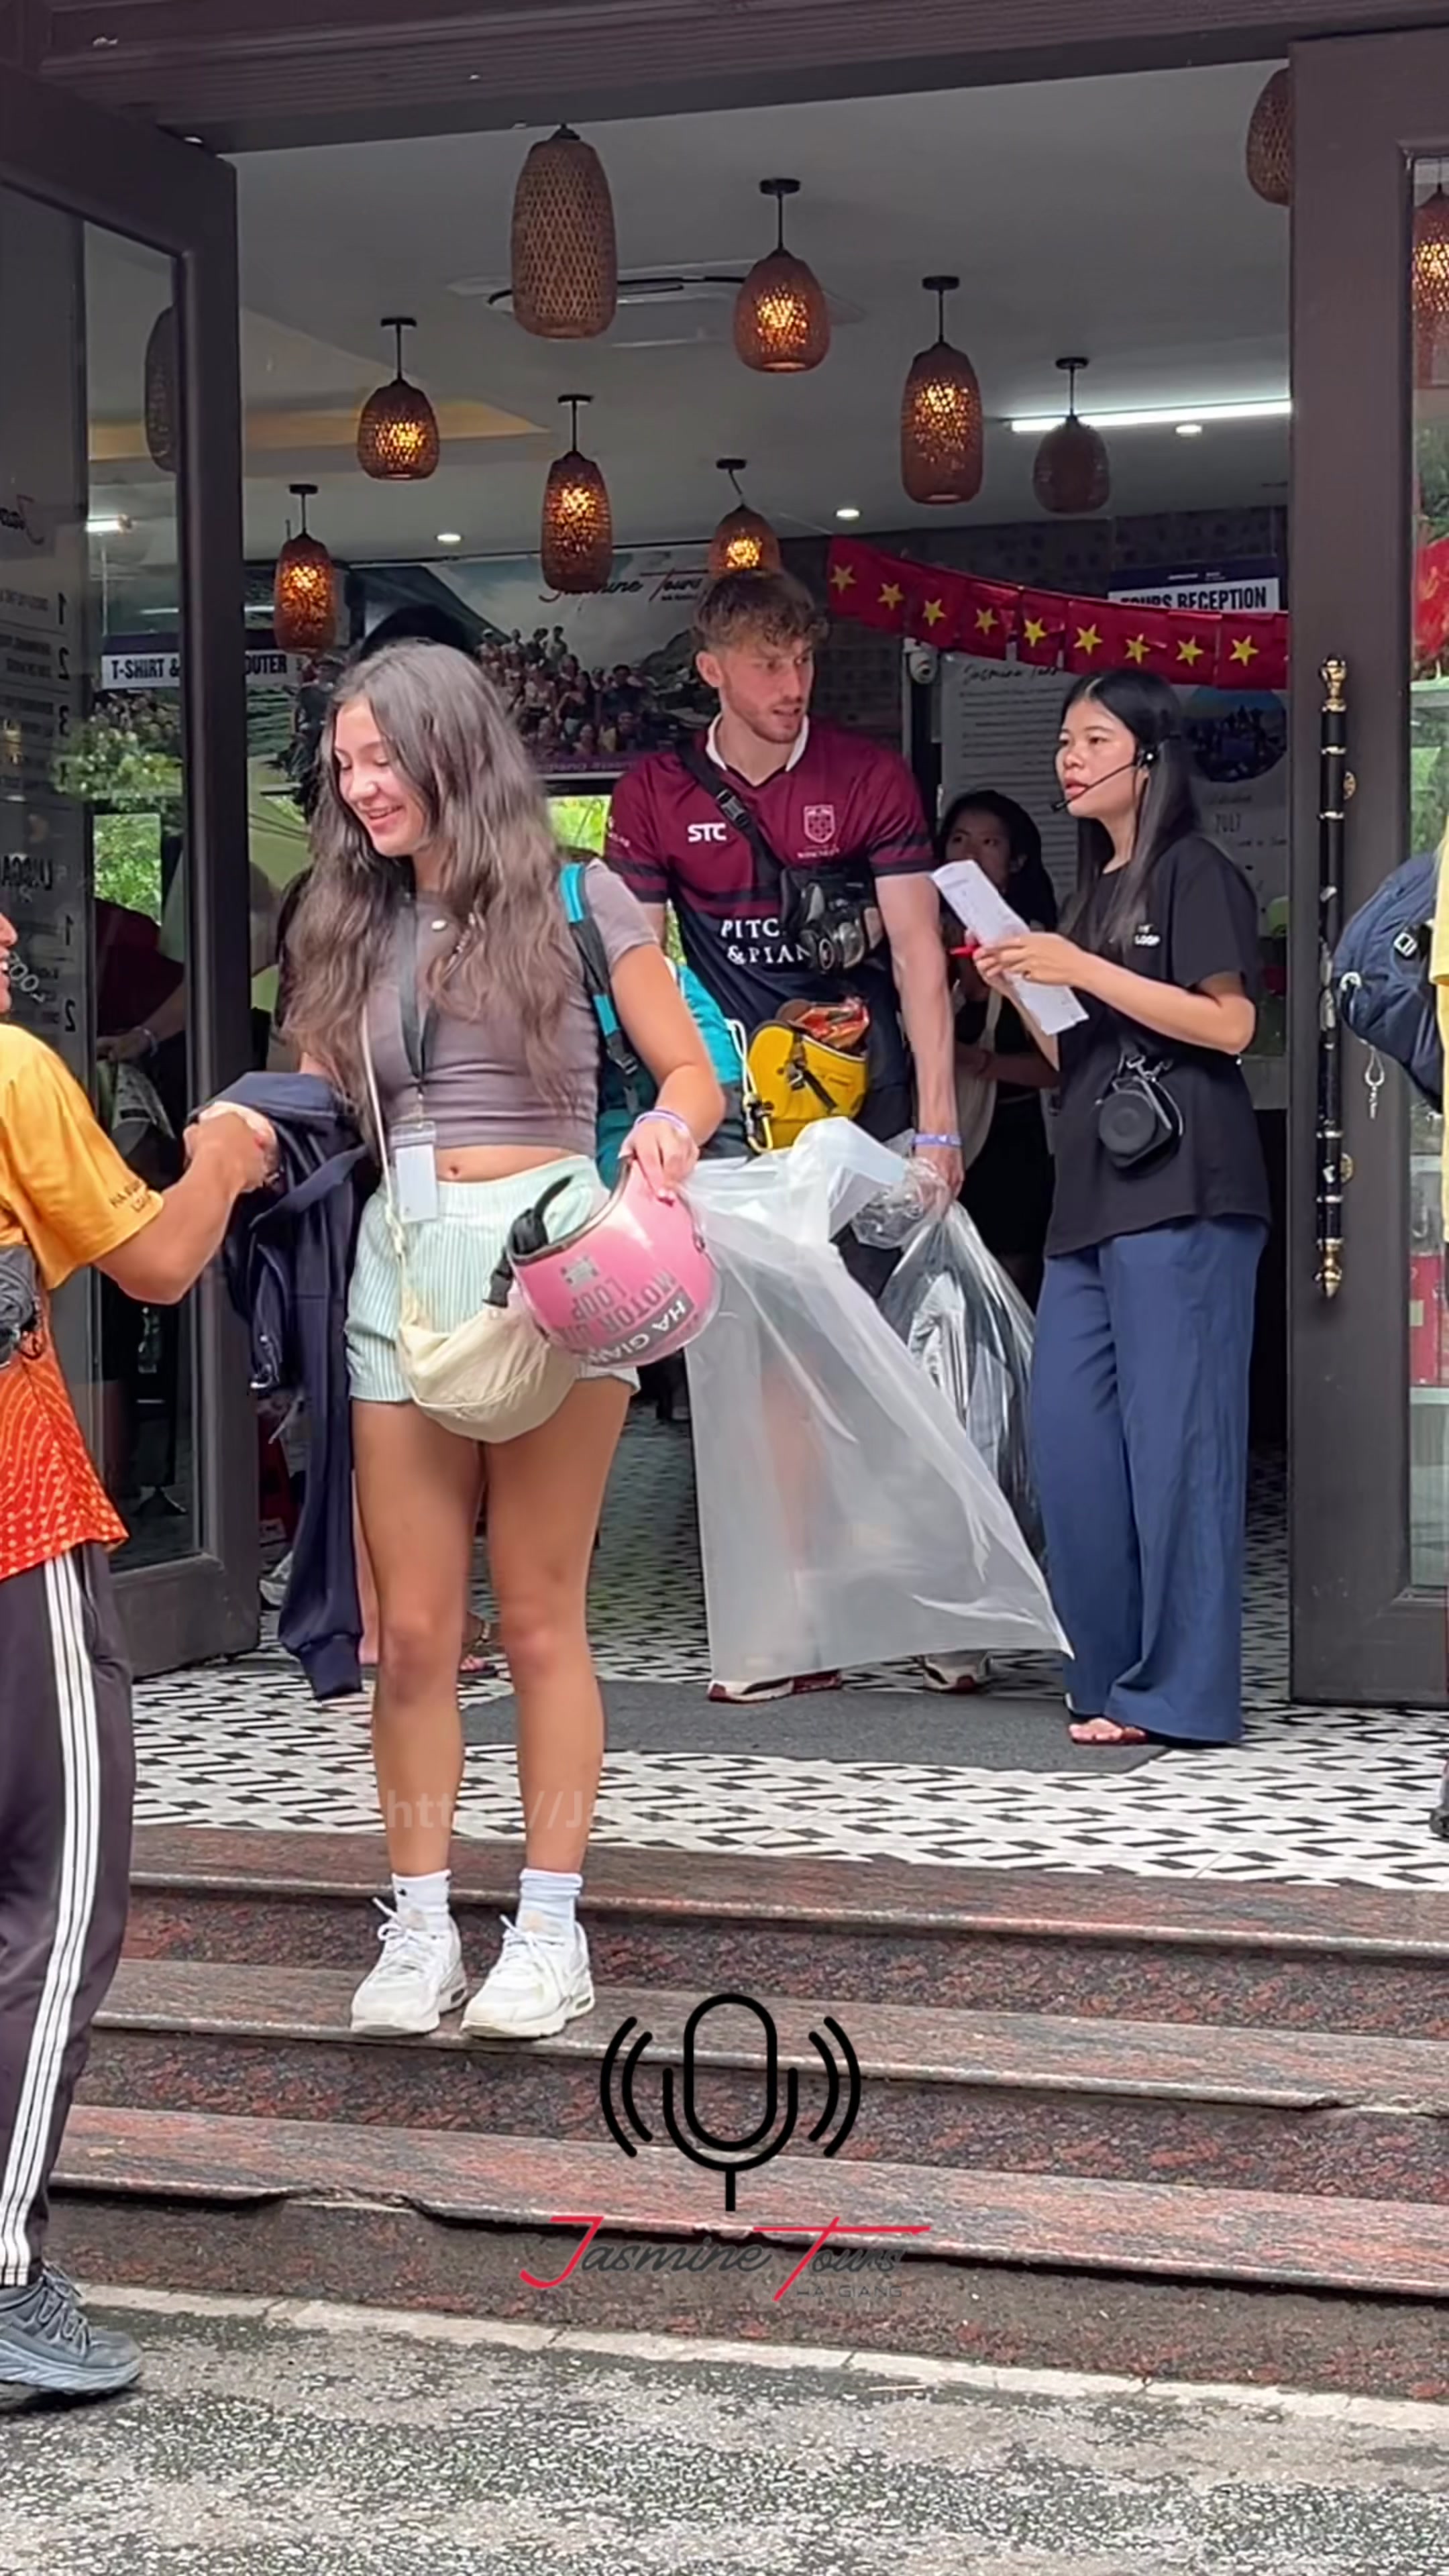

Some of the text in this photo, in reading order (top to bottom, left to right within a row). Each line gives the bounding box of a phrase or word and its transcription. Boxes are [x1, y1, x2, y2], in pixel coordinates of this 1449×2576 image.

[1177, 586, 1267, 610] RECEPTION
[111, 658, 164, 680] T-SHIRT
[170, 657, 180, 678] &
[688, 822, 727, 843] STC
[720, 917, 780, 938] PITC
[572, 1276, 628, 1321] LOOP
[651, 1299, 686, 1332] HA
